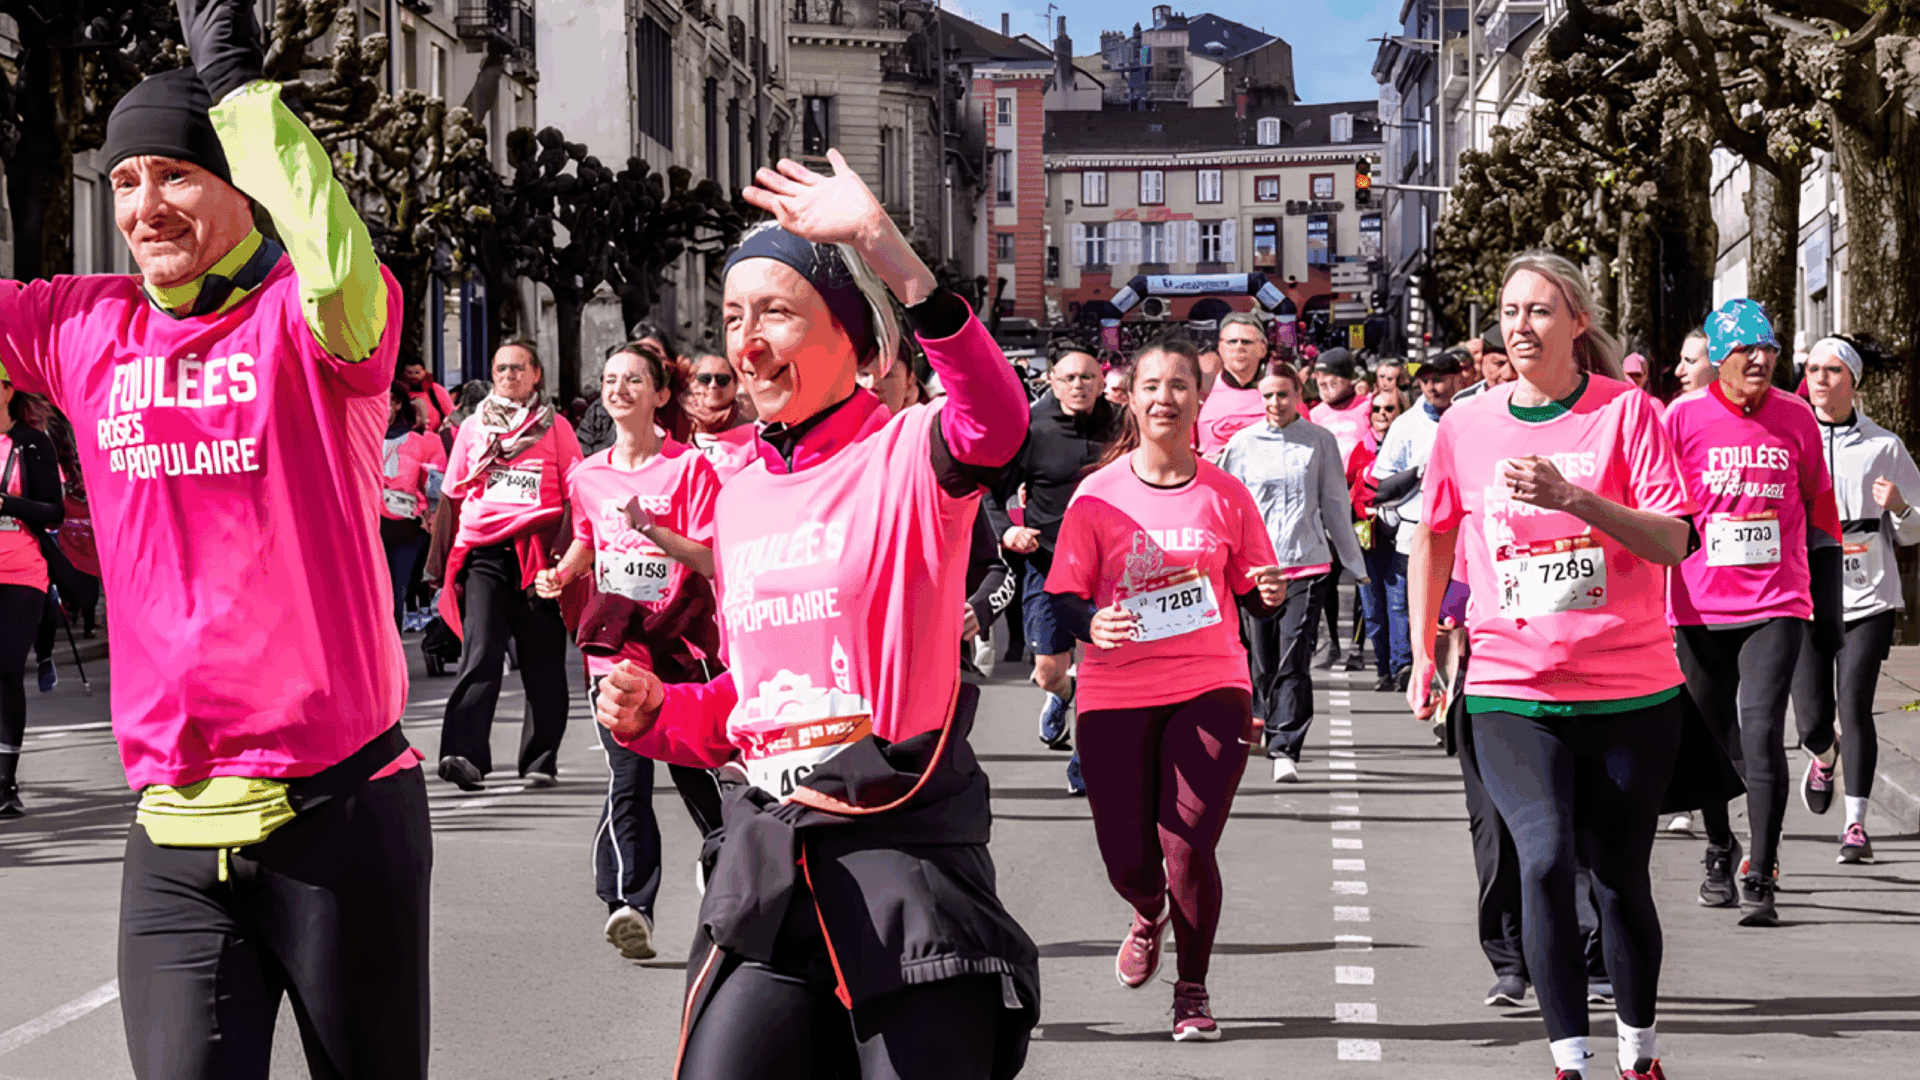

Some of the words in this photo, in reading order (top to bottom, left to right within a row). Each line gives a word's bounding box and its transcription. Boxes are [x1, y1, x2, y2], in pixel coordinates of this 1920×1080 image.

[108, 352, 257, 418] FOULÉES
[125, 437, 260, 481] POPULAIRE
[1708, 443, 1790, 471] FOULÉES
[1538, 558, 1595, 584] 7289
[731, 587, 842, 636] POPULAIRE
[1156, 587, 1202, 613] 7287
